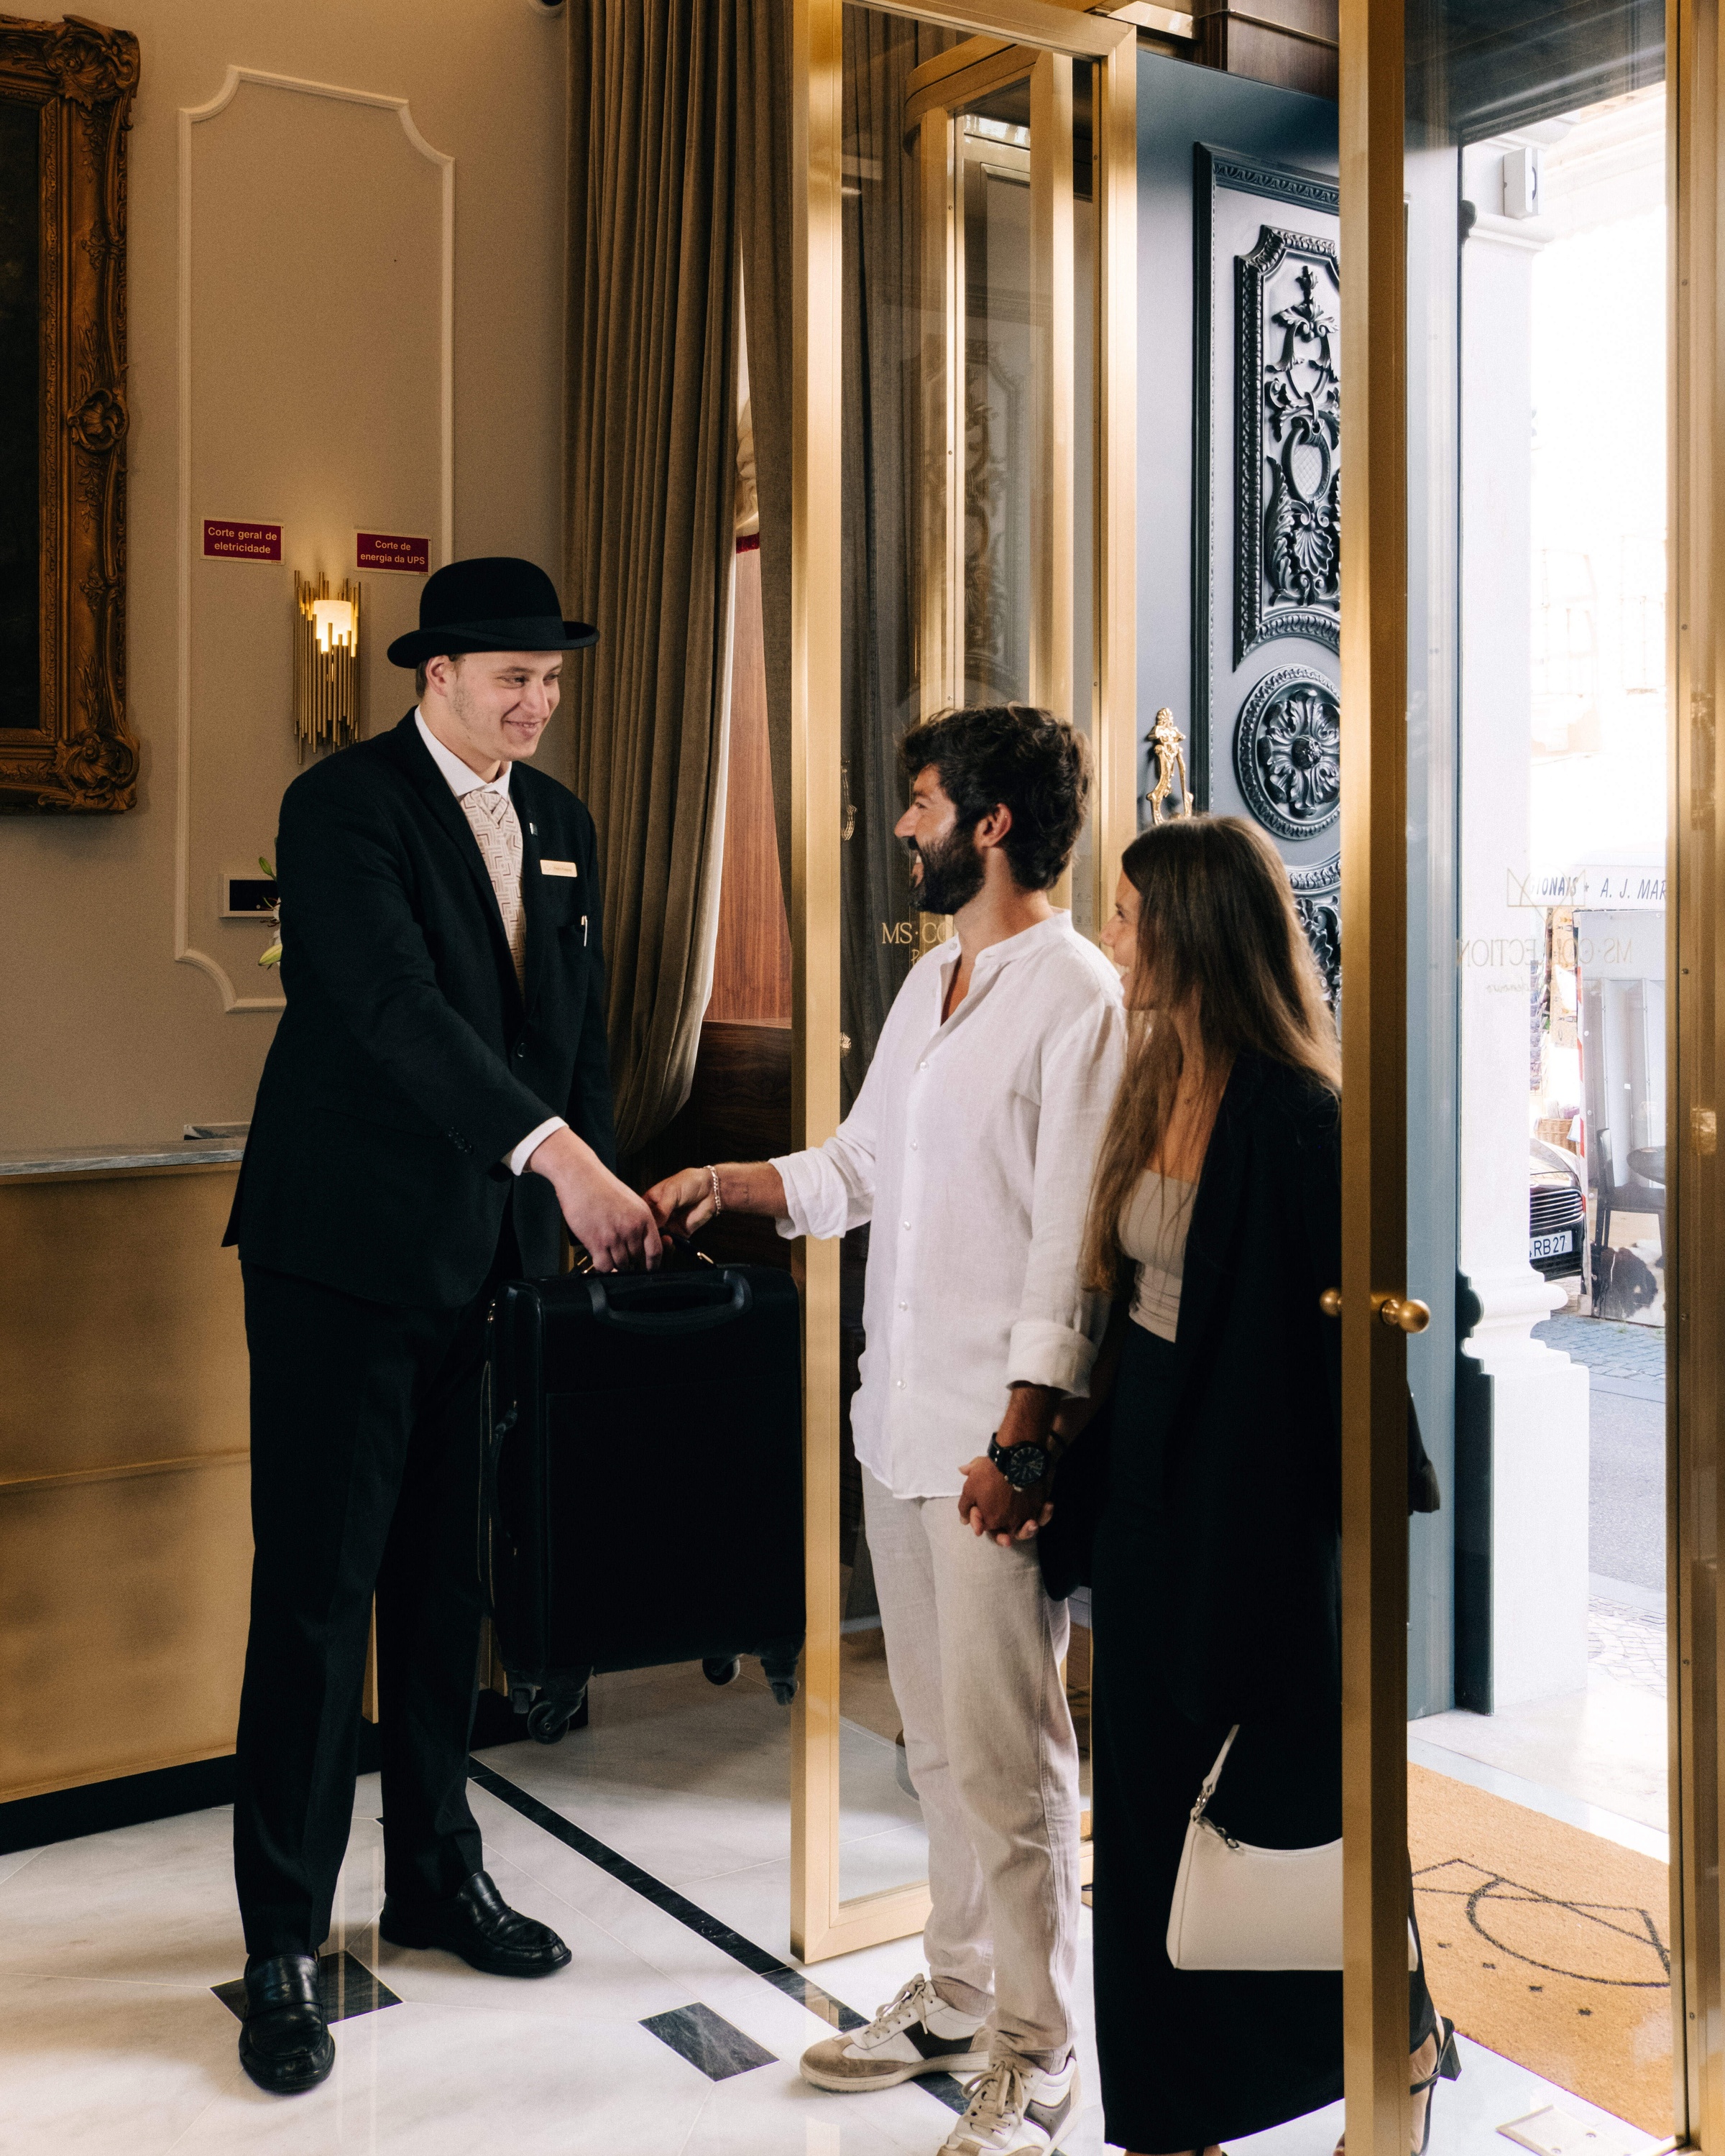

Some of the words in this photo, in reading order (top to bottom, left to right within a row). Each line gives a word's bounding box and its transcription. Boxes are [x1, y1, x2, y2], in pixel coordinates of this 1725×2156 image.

[208, 527, 234, 538] Corte
[238, 531, 262, 540] geral
[265, 532, 277, 540] de
[214, 542, 271, 553] eletricidade
[375, 540, 398, 549] Corte
[360, 553, 392, 563] energia
[407, 556, 426, 565] UPS
[1600, 877, 1612, 898] A.
[1619, 878, 1630, 899] J.
